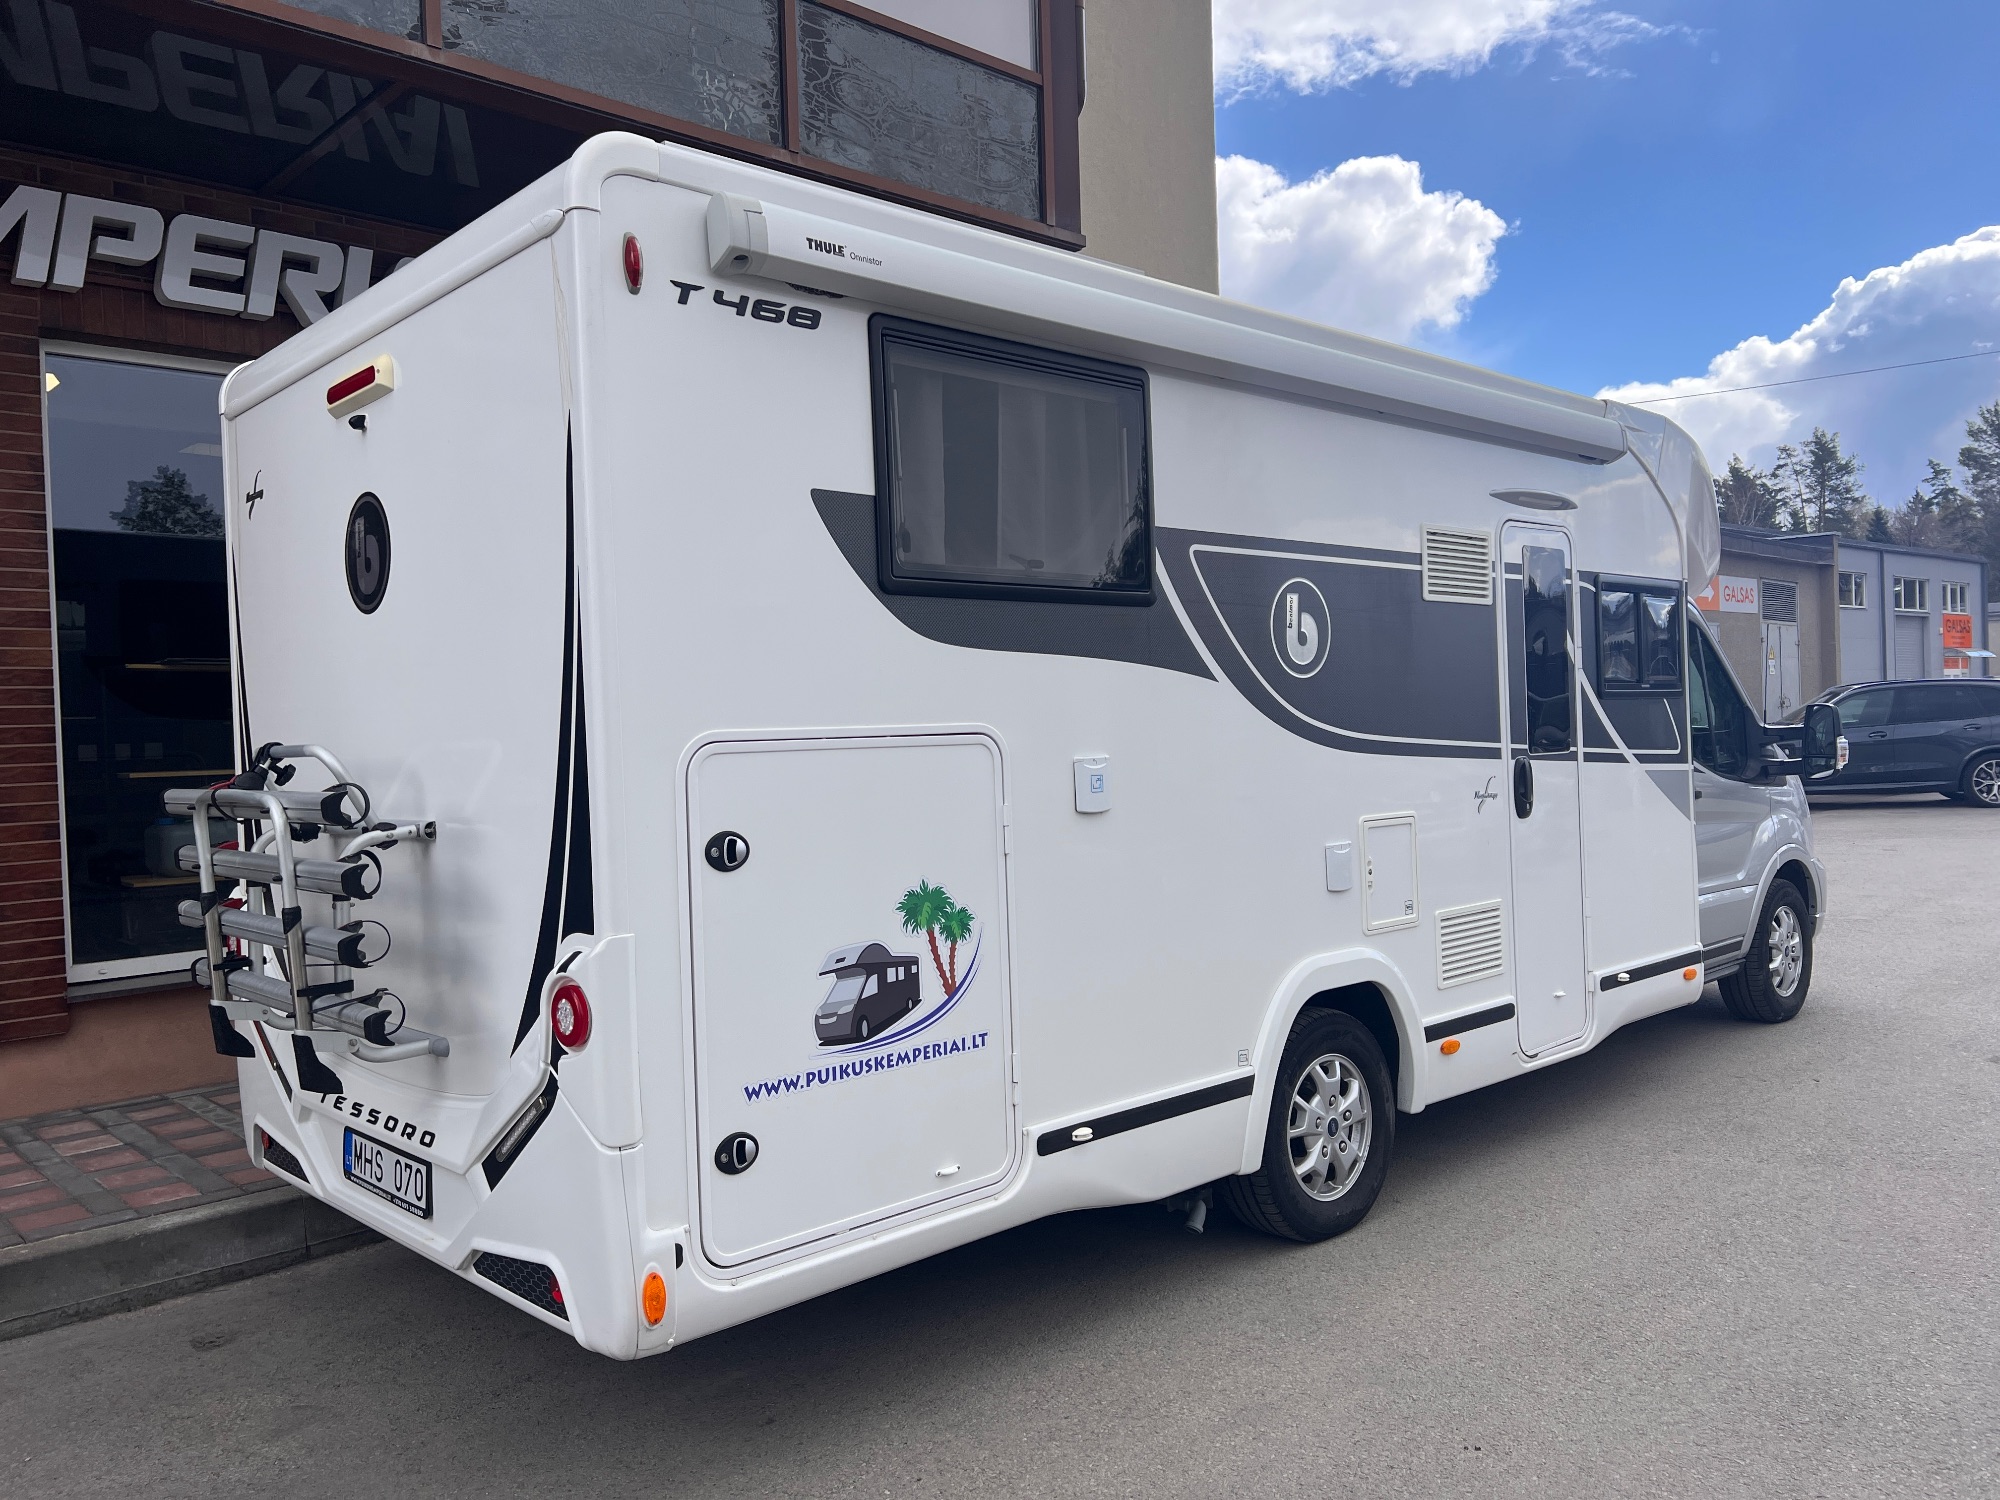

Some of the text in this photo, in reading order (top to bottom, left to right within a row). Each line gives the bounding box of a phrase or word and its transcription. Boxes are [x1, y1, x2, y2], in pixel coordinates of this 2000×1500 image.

[806, 237, 883, 267] THULE Omnistor
[669, 279, 822, 330] T 468
[1723, 585, 1755, 604] GALSAS
[1945, 619, 1971, 634] GALSAS
[743, 1032, 989, 1102] WWW.PUIKUSKEMPERIAI.LT
[353, 1138, 384, 1183] MHS
[394, 1159, 424, 1202] 070
